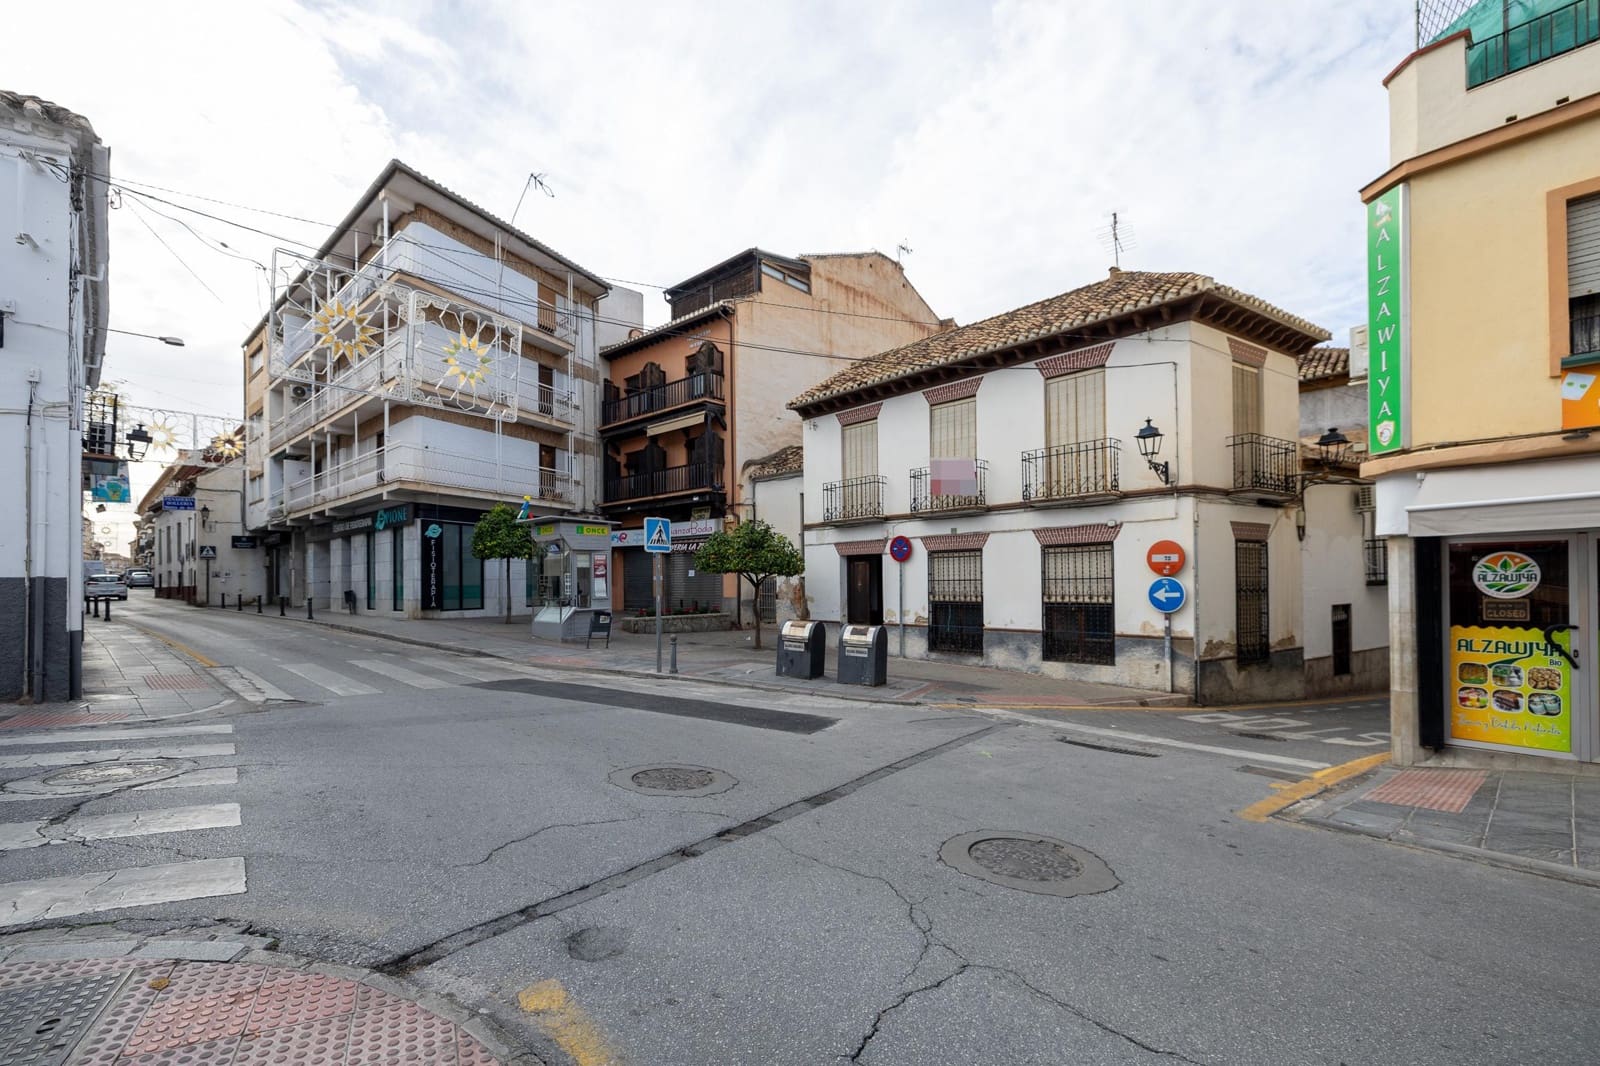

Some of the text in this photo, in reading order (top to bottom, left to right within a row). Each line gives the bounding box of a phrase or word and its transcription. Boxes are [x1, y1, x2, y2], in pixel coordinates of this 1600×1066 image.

[1376, 227, 1396, 420] ALZAWIYA
[429, 539, 437, 608] FISIOTERAPIA
[1487, 610, 1526, 618] CLOSED
